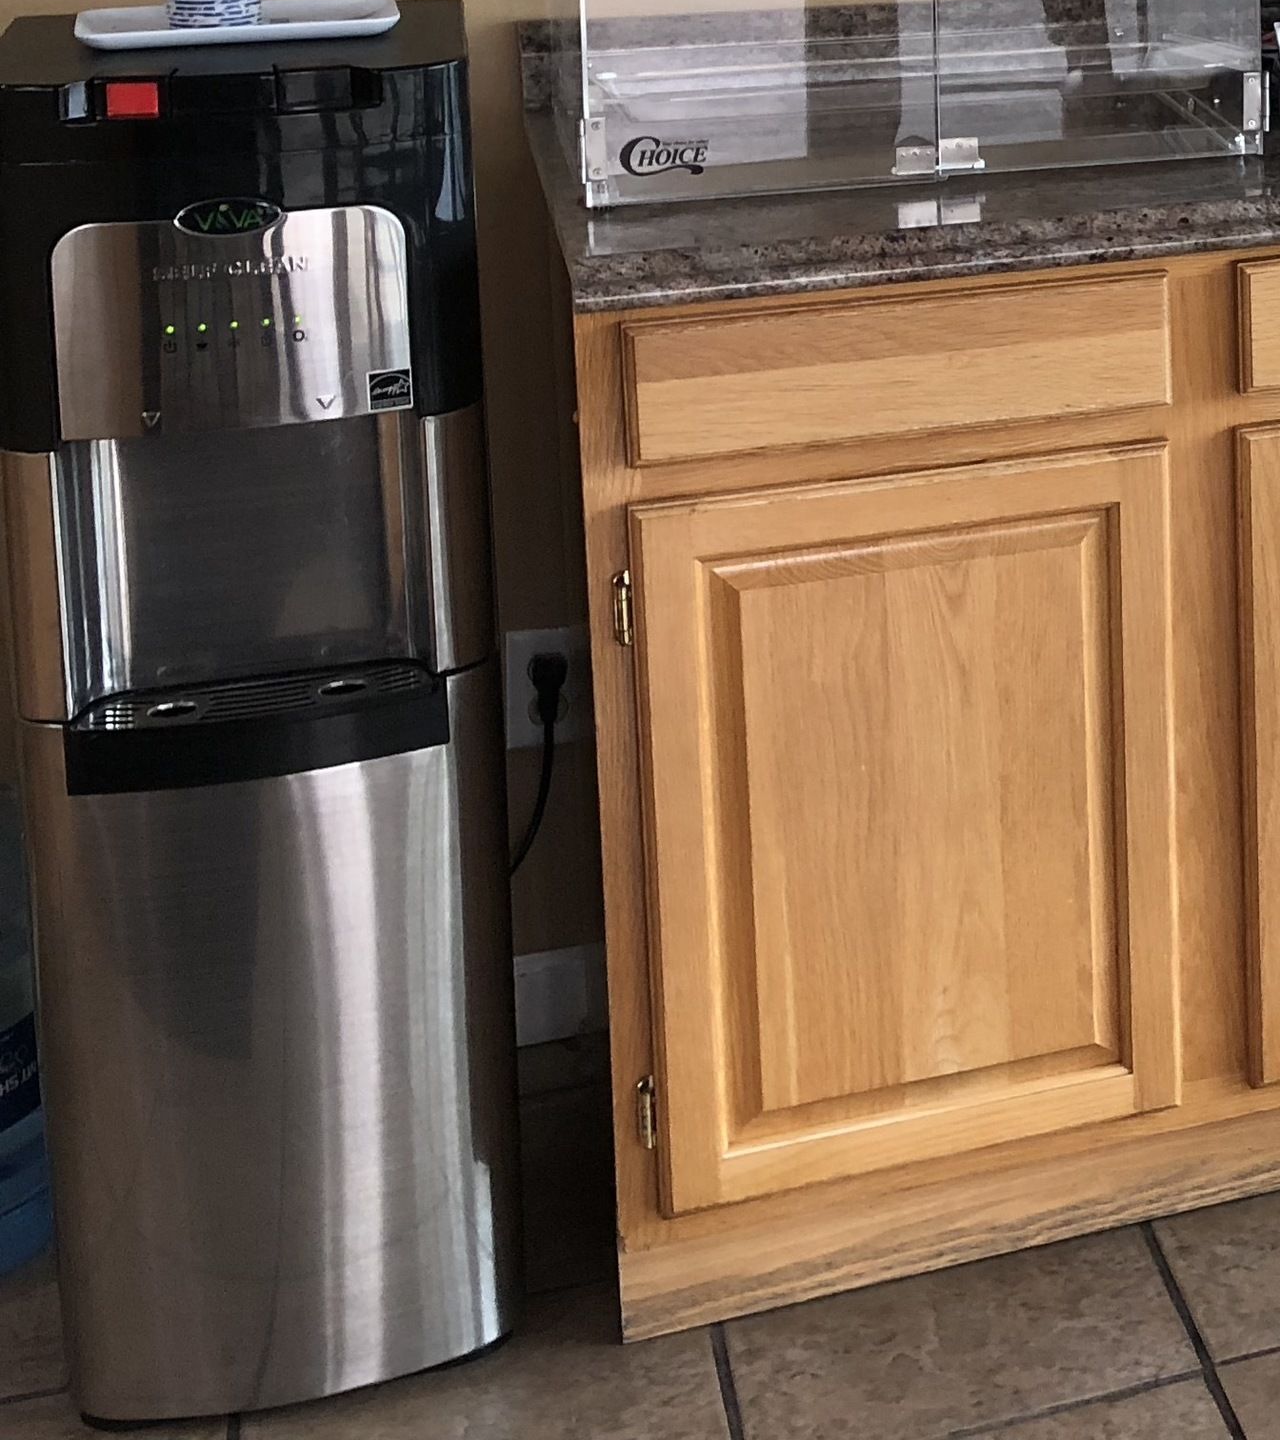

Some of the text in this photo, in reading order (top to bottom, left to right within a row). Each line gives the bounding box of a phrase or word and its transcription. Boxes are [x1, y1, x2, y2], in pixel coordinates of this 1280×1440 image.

[619, 135, 708, 177] CHOICE
[151, 255, 310, 281] SELF CLEAN
